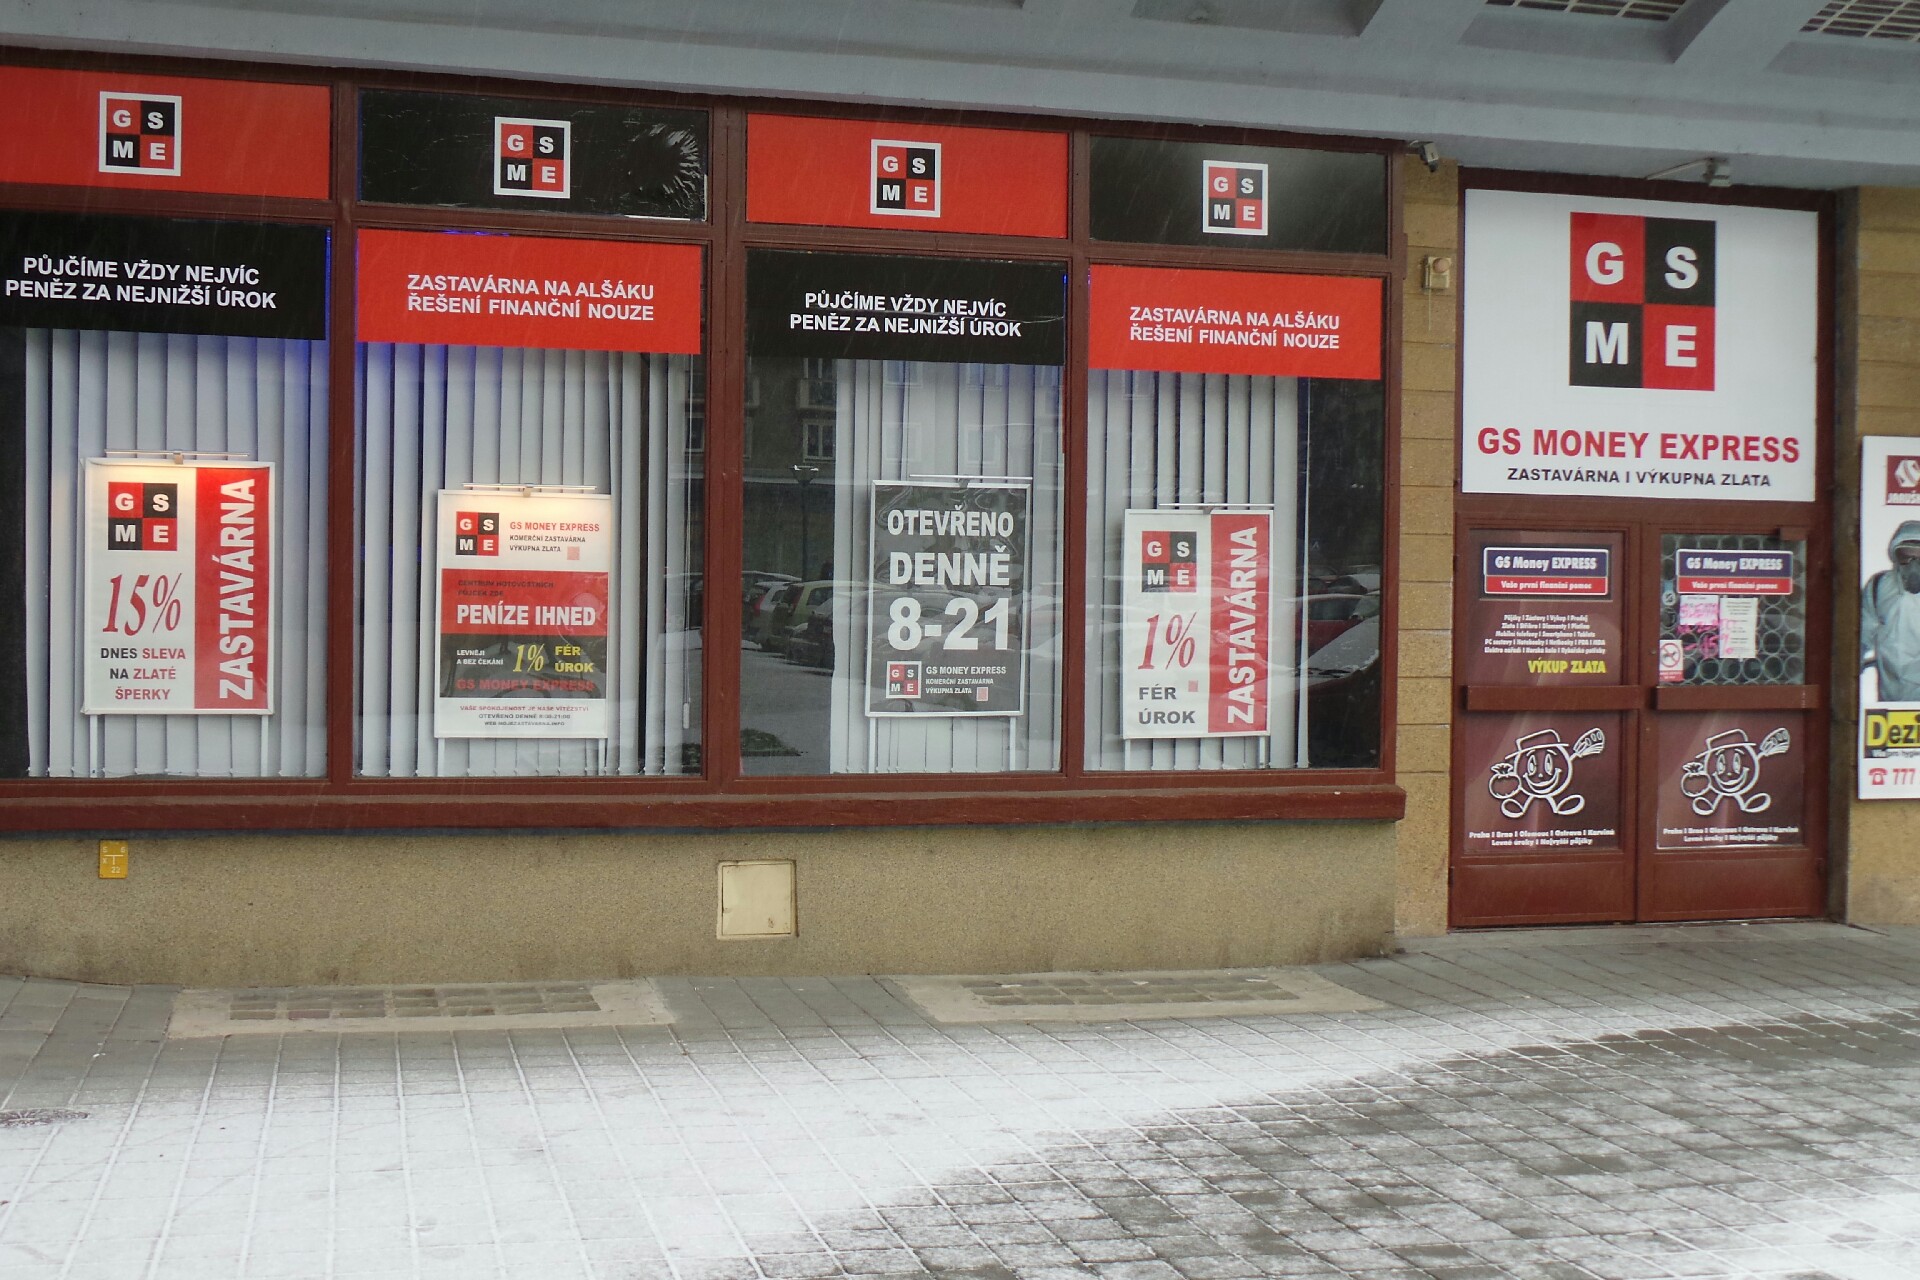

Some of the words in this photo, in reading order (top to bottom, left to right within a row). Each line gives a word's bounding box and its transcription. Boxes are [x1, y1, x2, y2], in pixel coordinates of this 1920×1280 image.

[23, 253, 118, 279] PŮJČÍME
[124, 259, 181, 282] VŽDY
[185, 264, 260, 285] NEJVÍC
[5, 278, 77, 299] PENĚZ
[82, 283, 111, 301] ZA
[116, 284, 210, 306] NEJNIŽŠÍ
[216, 287, 277, 309] ÚROK
[407, 274, 539, 295] ZASTAVÁRNA
[544, 280, 571, 296] NA
[575, 280, 654, 300] ALŠÁKU
[407, 294, 481, 314] ŘEŠENÍ
[488, 298, 580, 318] FINANČNÍ
[588, 302, 654, 321] NOUZE
[805, 290, 886, 311] PŮJČÍME
[890, 294, 940, 313] VŽDY
[943, 298, 1007, 318] NEJVÍC
[790, 312, 851, 331] PENĚZ
[855, 317, 880, 332] ZA
[883, 316, 965, 336] NEJNIŽŠÍ
[970, 318, 1021, 337] ÚROK
[1129, 306, 1243, 325] ZASTAVÁRNA
[1246, 311, 1269, 327] NA
[1273, 310, 1340, 330] ALŠÁKU
[1129, 325, 1193, 344] ŘEŠENÍ
[1199, 328, 1277, 347] FINANČNÍ
[1283, 333, 1340, 349] NOUZE
[1477, 427, 1522, 456] GS
[1533, 429, 1649, 459] MONEY
[1660, 433, 1800, 463] EXPRESS
[1507, 466, 1620, 484] ZASTAVÁRNA
[1636, 469, 1716, 486] VÝKUPNA
[1721, 473, 1771, 487] ZLATA
[510, 521, 522, 530] GS
[525, 522, 556, 531] MONEY
[559, 523, 600, 532] EXPRESS
[888, 505, 1014, 537] OTEVŘENO
[890, 545, 1010, 586] DENNĚ
[1495, 556, 1511, 569] GS
[1513, 557, 1550, 571] Money
[1552, 557, 1598, 570] EXPRESS
[1686, 558, 1701, 569] GS
[1702, 557, 1737, 572] Money
[1740, 558, 1783, 570] EXPRESS
[212, 478, 255, 700] ZASTAVÁRNA
[103, 572, 182, 636] 15%
[457, 601, 529, 625] PENÍZE
[535, 606, 596, 626] IHNED
[888, 597, 1008, 651] 8-21
[1224, 527, 1257, 724] ZASTAVÁRNA
[555, 643, 581, 656] FÉR
[1138, 611, 1198, 670] 1%
[101, 648, 138, 659] DNES
[142, 648, 186, 660] SLEVA
[513, 643, 545, 673] 1%
[1527, 657, 1568, 673] VÝKUP
[1570, 660, 1606, 673] ZLATA
[110, 668, 129, 679] NA
[133, 665, 176, 680] ZLATÉ
[554, 660, 594, 673] ÚROK
[926, 667, 938, 675] GS
[939, 667, 969, 675] MONEY
[970, 667, 1006, 675] EXPRESS
[115, 686, 170, 700] ŠPERKY
[479, 679, 528, 691] MONEY
[1139, 684, 1176, 700] FÉR
[1138, 708, 1196, 724] ÚROK
[1893, 768, 1916, 785] 777
